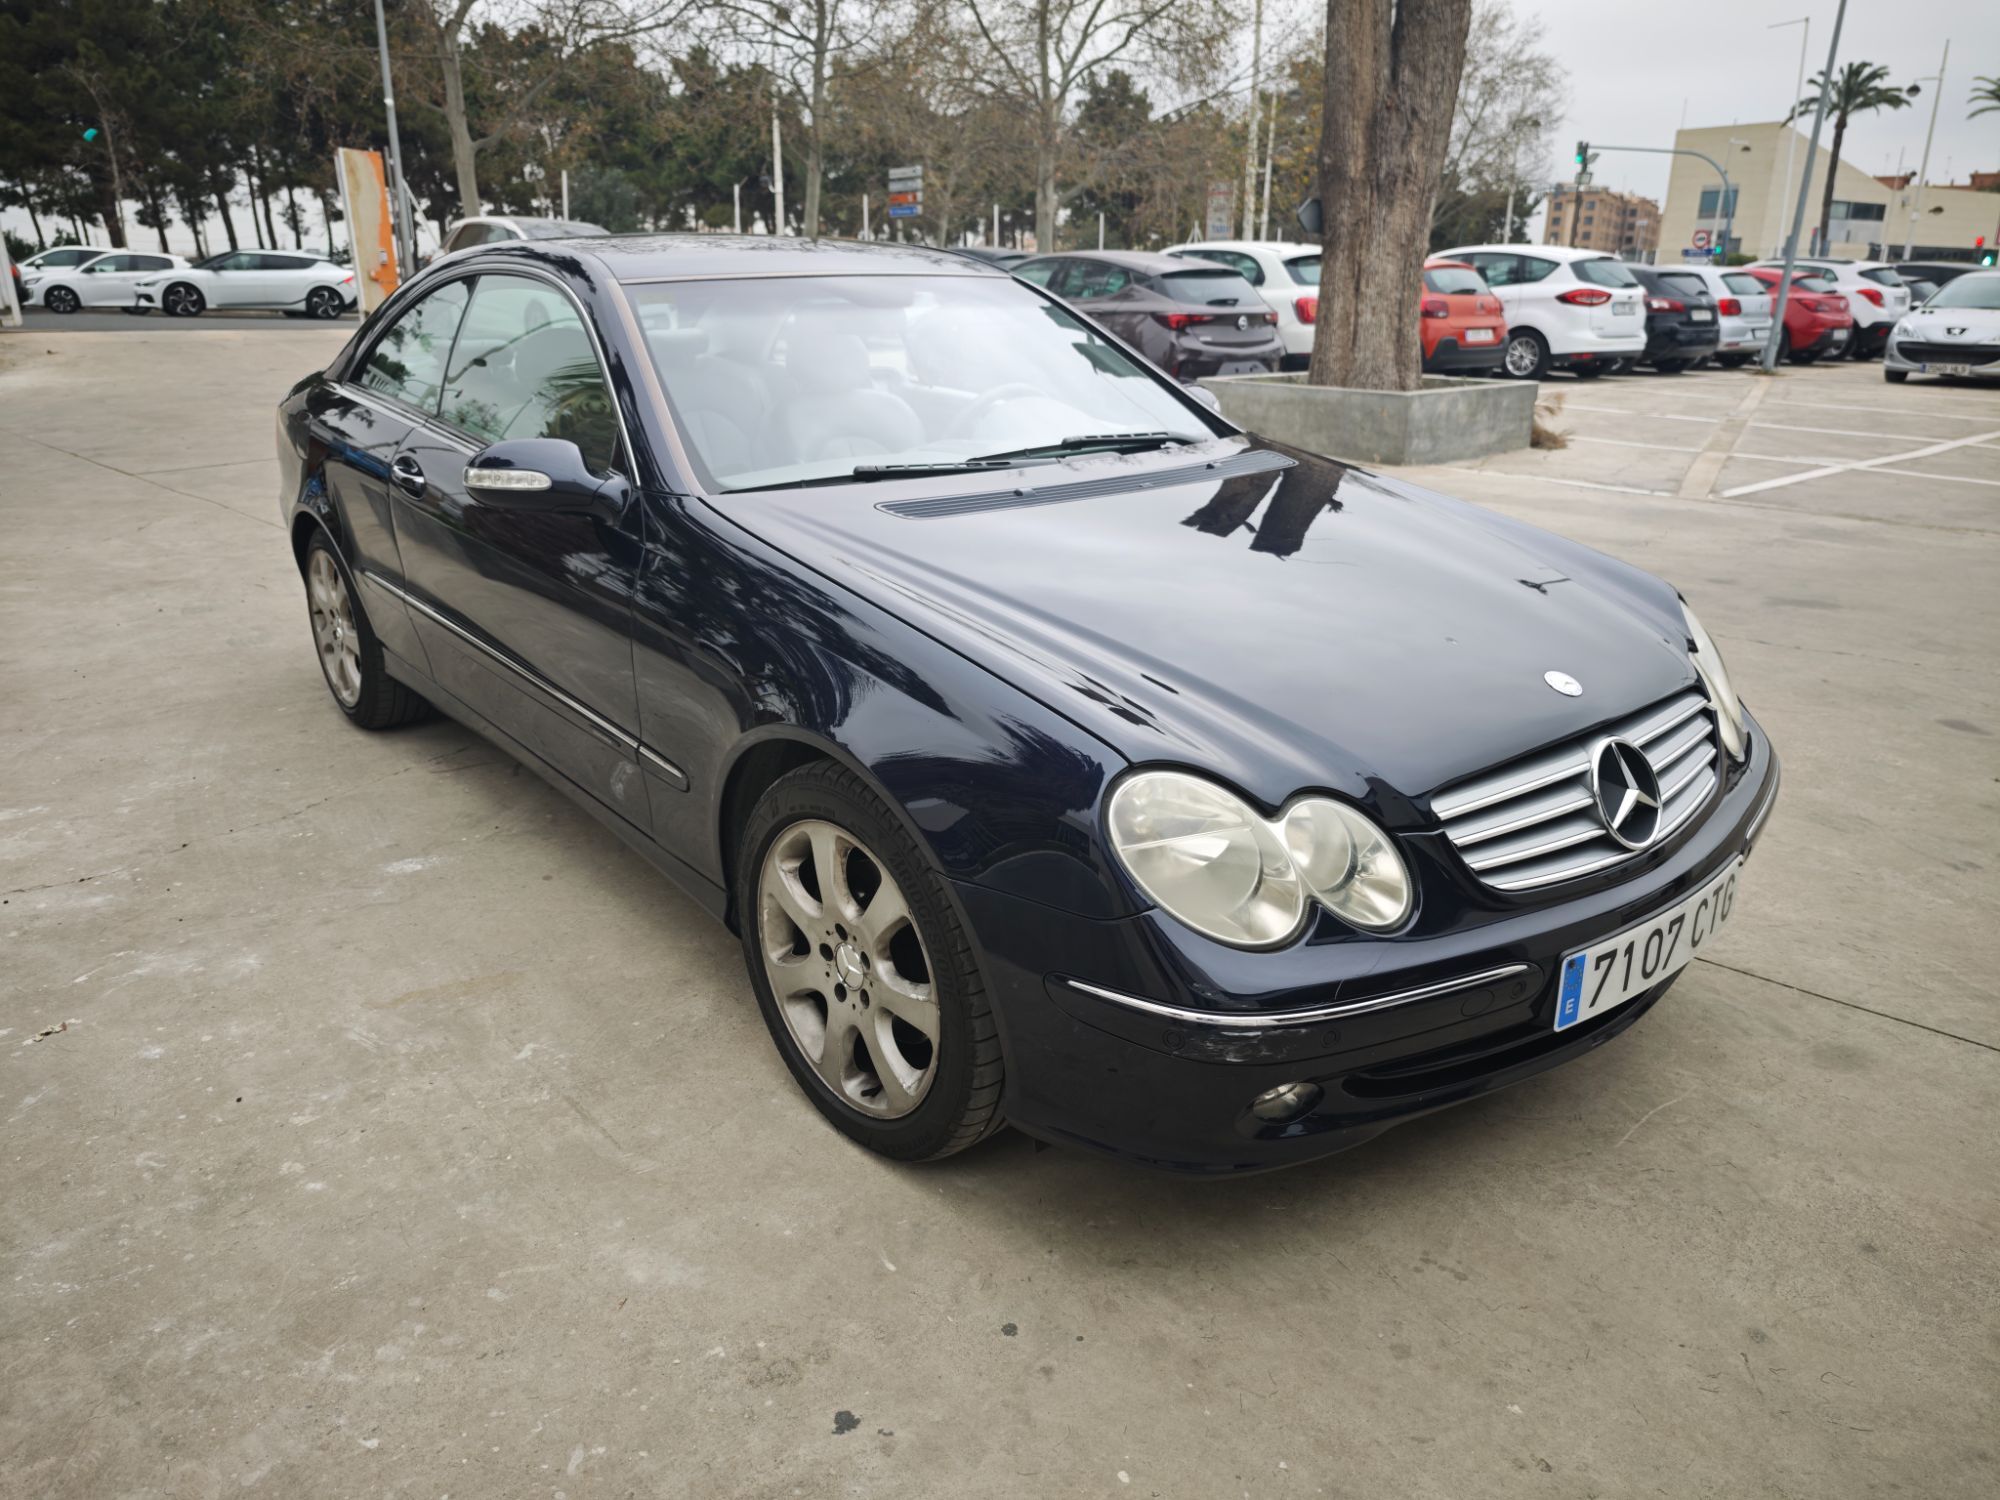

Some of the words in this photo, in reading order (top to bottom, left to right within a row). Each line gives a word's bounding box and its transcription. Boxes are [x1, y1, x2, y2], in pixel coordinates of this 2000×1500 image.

[888, 851, 955, 1001] BRIDGESTONE
[1588, 912, 1686, 1009] 7107
[1690, 872, 1736, 949] CTG
[1564, 997, 1575, 1015] E
